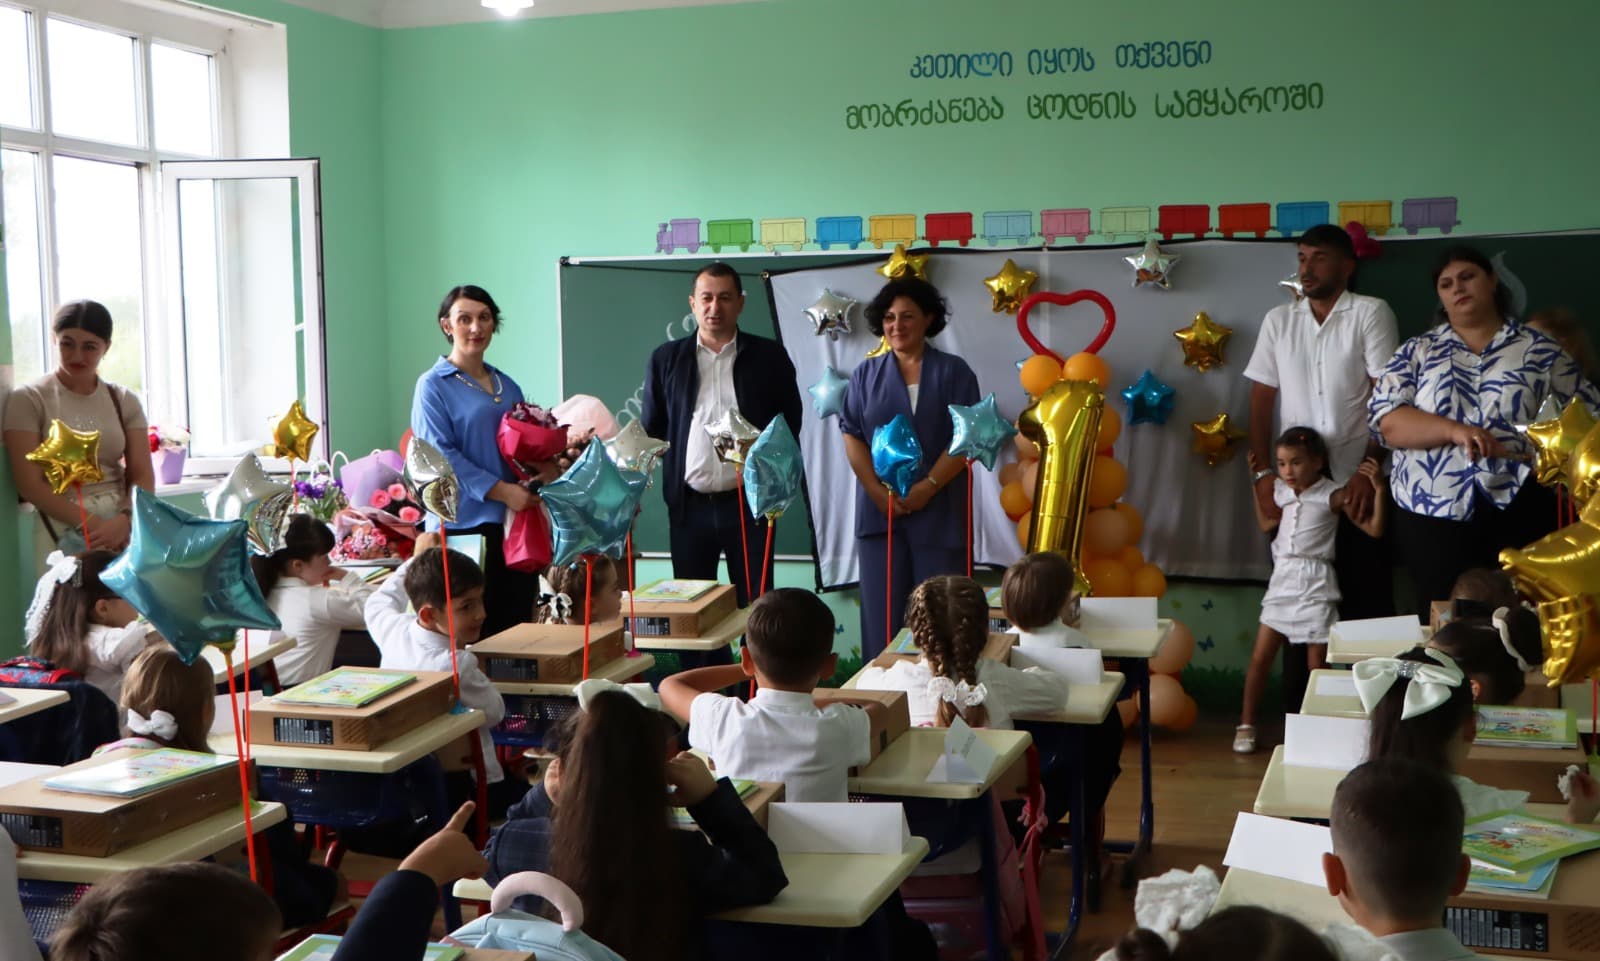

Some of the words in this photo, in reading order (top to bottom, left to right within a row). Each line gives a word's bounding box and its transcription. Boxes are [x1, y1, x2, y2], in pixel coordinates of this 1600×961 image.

[910, 51, 1013, 79] კეთილი
[1028, 48, 1095, 75] იყოს
[1116, 40, 1212, 69] თქვენი
[846, 96, 1004, 130] მობრძანება
[1027, 91, 1136, 120] ცოდნის
[1155, 82, 1323, 119] სამყაროში
